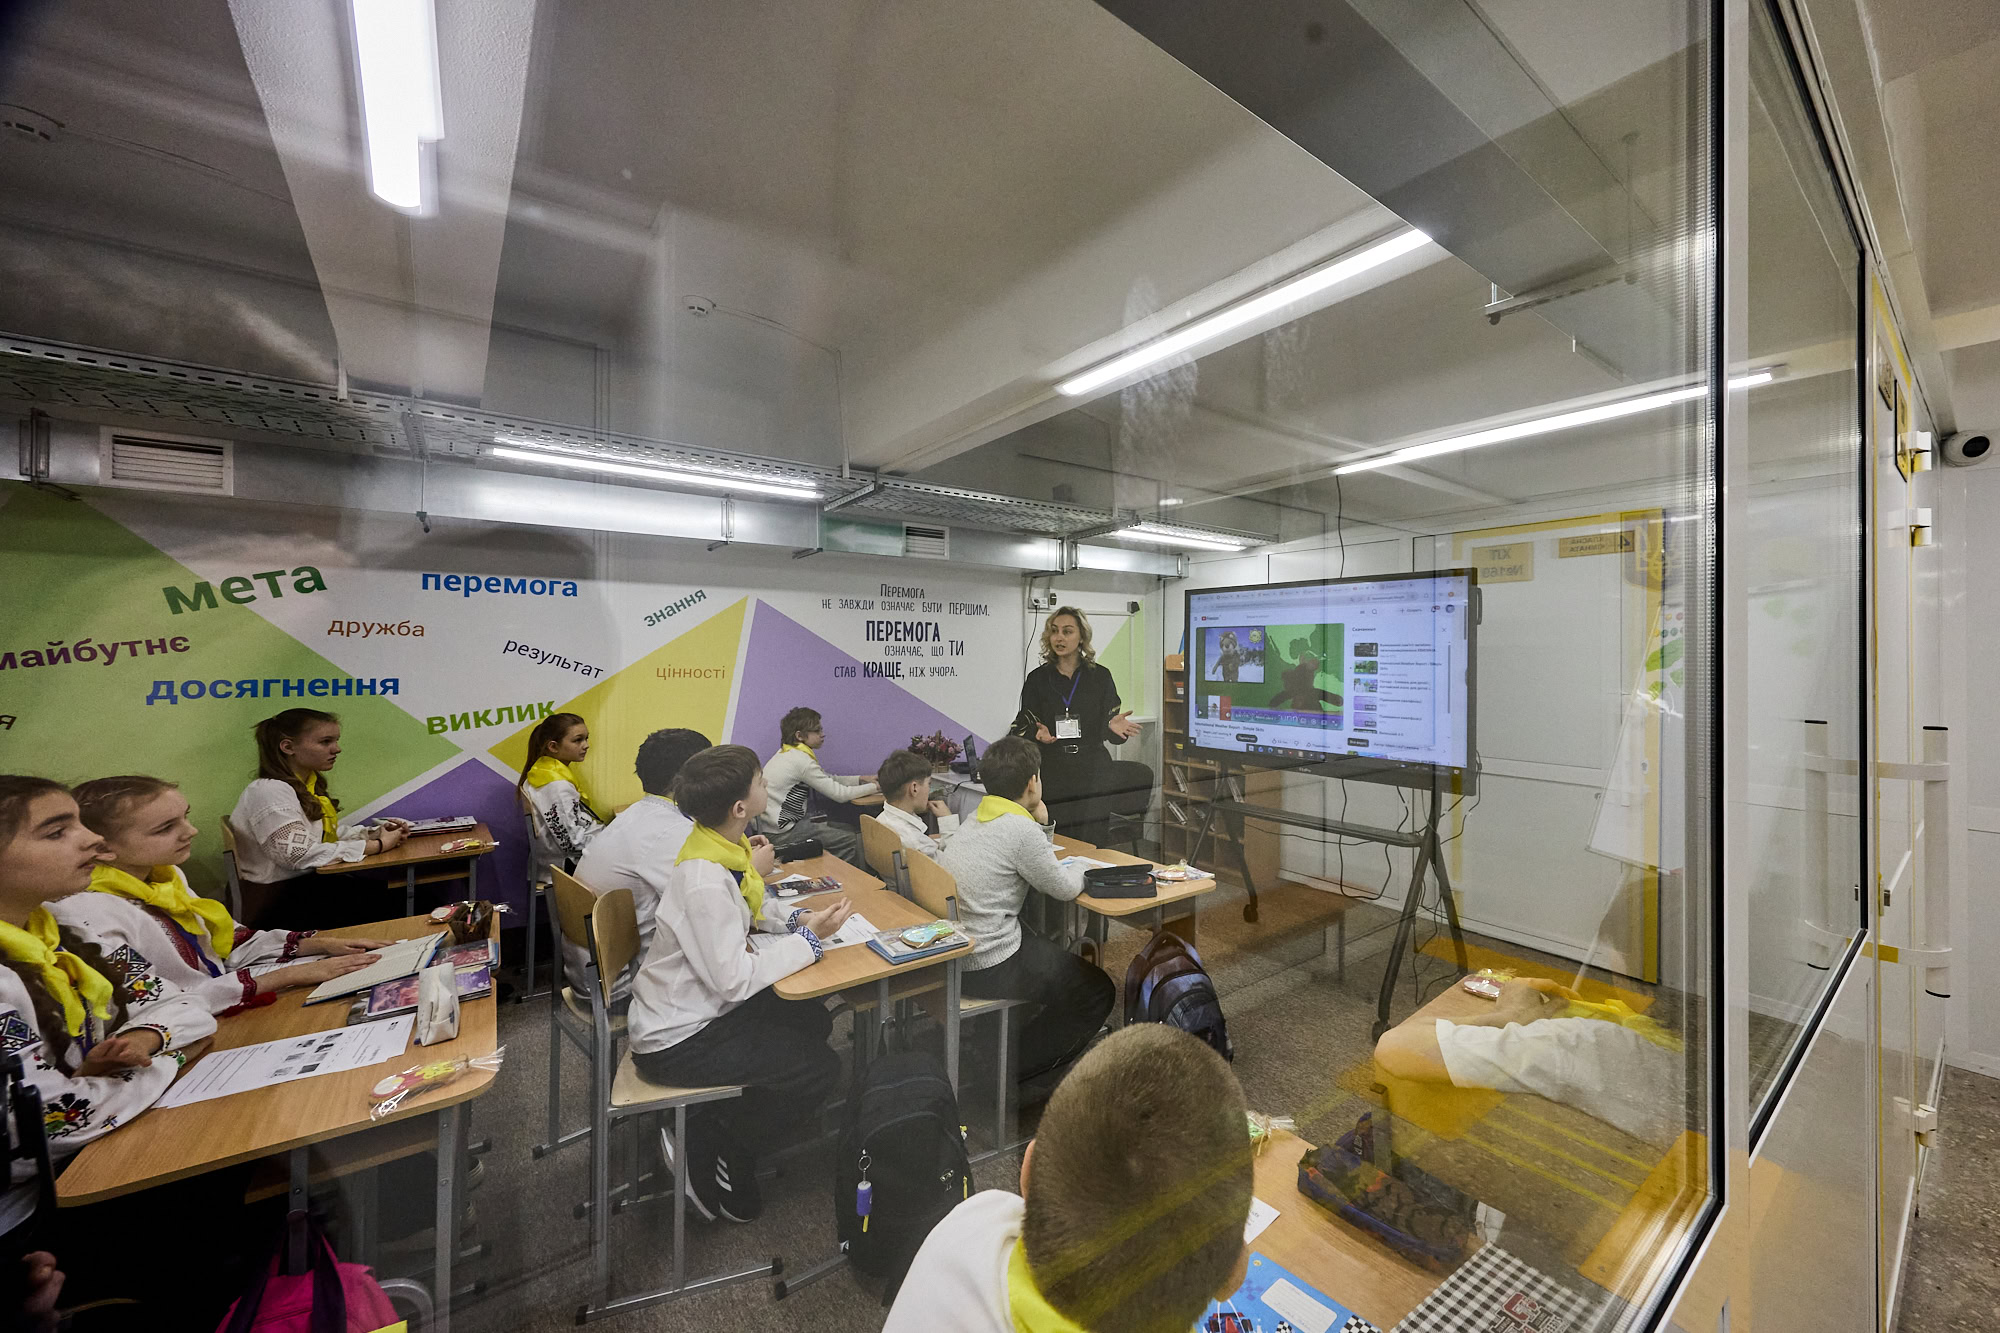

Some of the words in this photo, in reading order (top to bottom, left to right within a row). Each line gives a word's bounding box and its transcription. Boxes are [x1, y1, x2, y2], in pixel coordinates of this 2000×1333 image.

[162, 566, 328, 615] мета
[421, 571, 579, 598] перемога
[644, 588, 708, 627] знання
[821, 598, 832, 609] НЕ
[838, 599, 875, 611] ЗАВЖДИ
[880, 600, 915, 612] ОЗНАЧАЄ
[922, 602, 942, 613] БУТИ
[948, 602, 991, 617] ПЕРШИМ.
[327, 616, 426, 639] дружба
[866, 620, 941, 643] ПЕРЕМОГА
[503, 637, 605, 680] результат
[884, 645, 924, 658] ОЗНАЧАЄ,
[931, 646, 944, 657] ЩО
[948, 640, 964, 656] ТИ
[656, 665, 727, 681] цінності
[834, 665, 857, 678] СТАВ
[863, 661, 905, 680] КРАЩЕ,
[909, 666, 926, 677] НІЖ
[929, 666, 958, 677] УЧОРА.
[146, 674, 400, 705] досягнення
[425, 698, 556, 735] виклик
